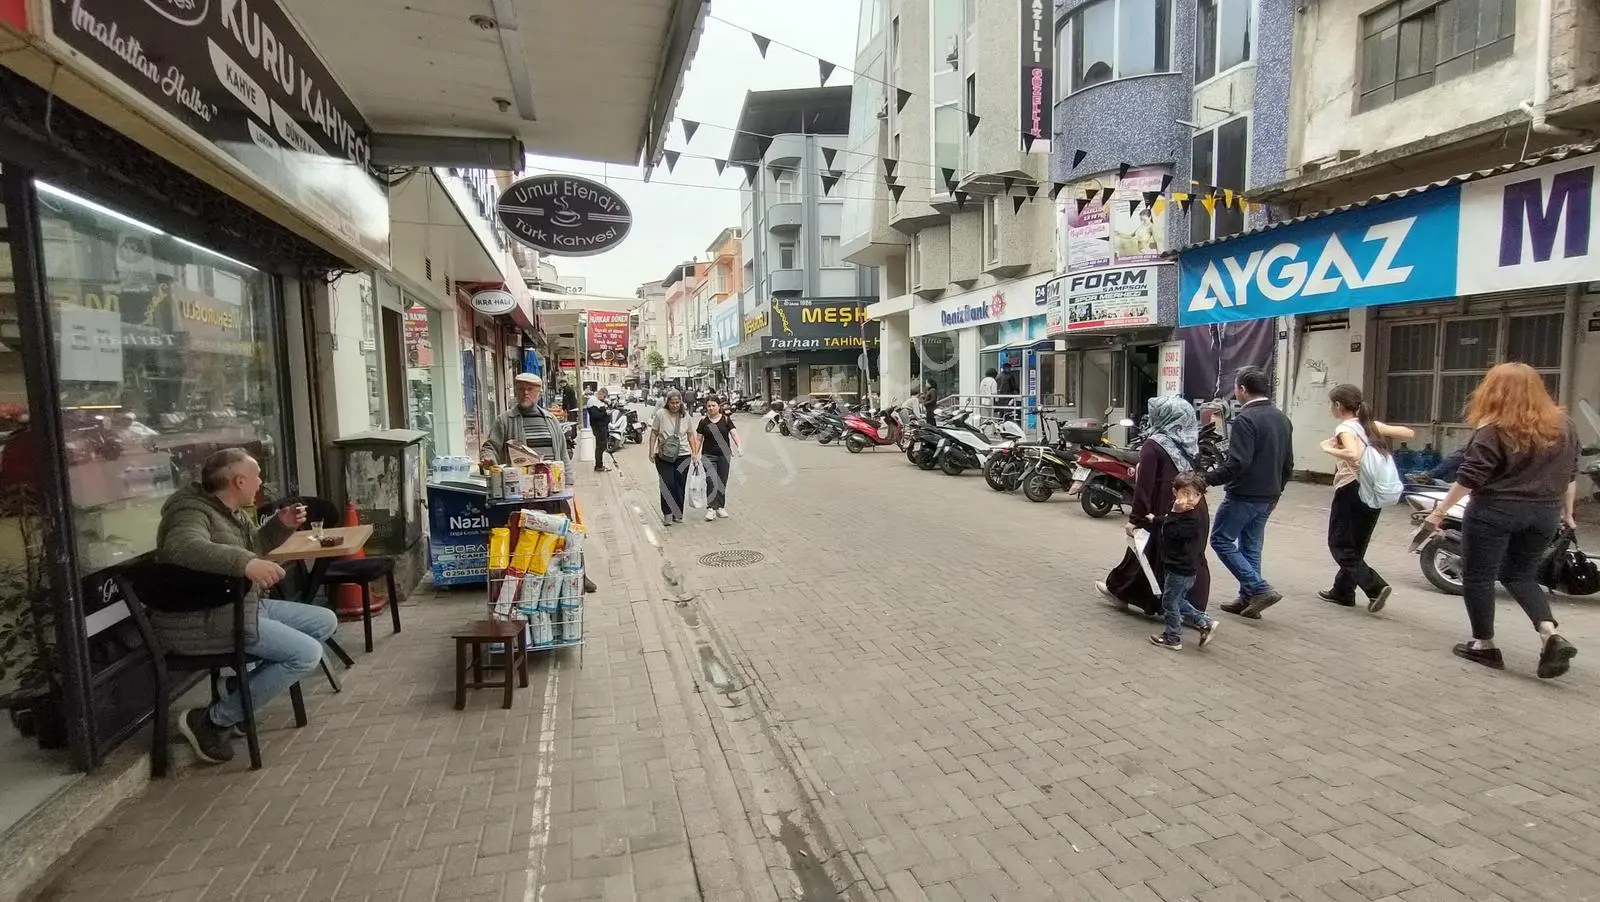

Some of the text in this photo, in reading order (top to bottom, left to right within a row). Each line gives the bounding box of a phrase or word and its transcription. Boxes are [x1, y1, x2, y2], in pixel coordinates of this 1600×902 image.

[221, 0, 295, 96] KURU
[225, 63, 257, 106] KAHVE
[514, 180, 559, 204] Umut
[514, 218, 618, 247] Türk Kahvesi
[1187, 215, 1418, 312] AYGAZ
[1035, 286, 1046, 297] 24
[1070, 270, 1148, 292] FORM
[1102, 284, 1148, 293] SAMPSON
[801, 306, 880, 328] MEŞH
[941, 300, 990, 327] DenizBank
[769, 338, 820, 348] Tarhan
[823, 335, 864, 347] TAHİN
[1165, 381, 1177, 391] CAFE
[449, 515, 490, 530] Nazlı
